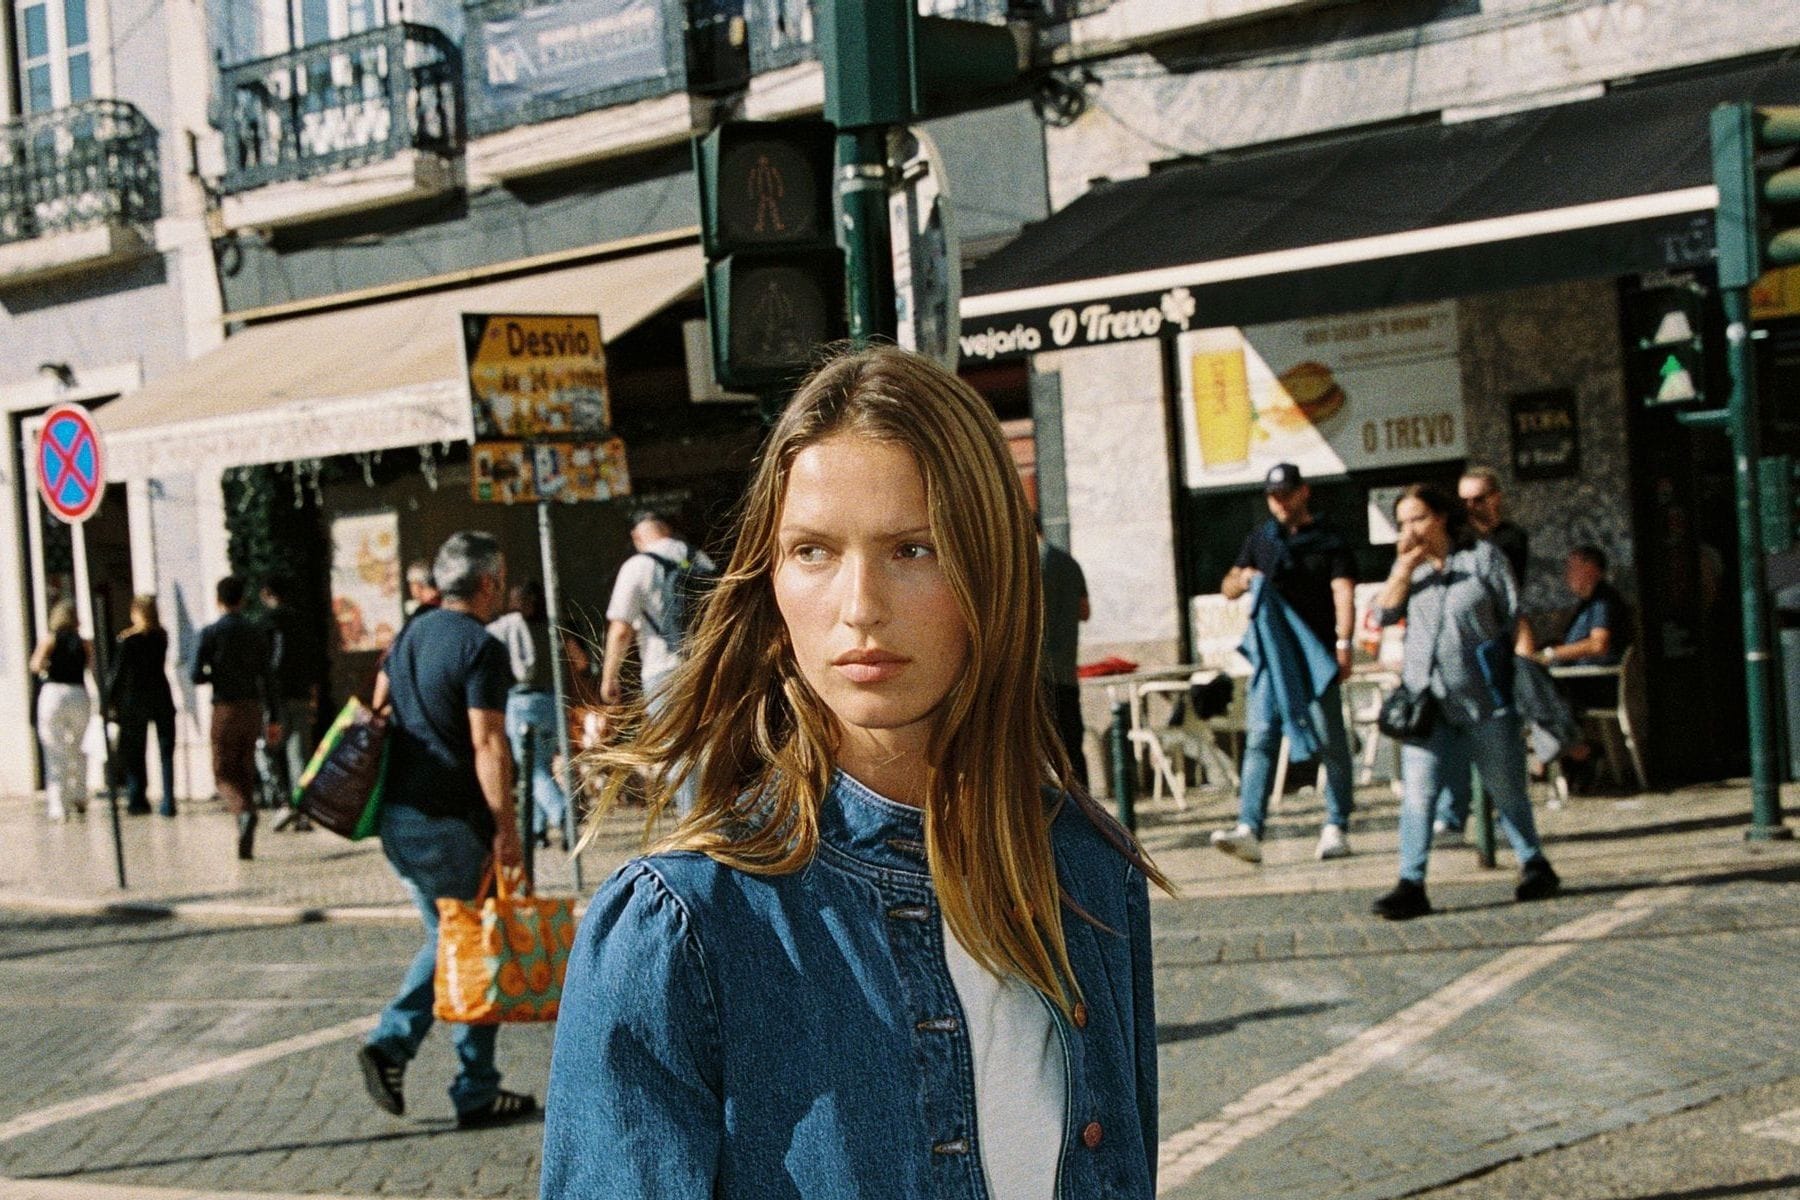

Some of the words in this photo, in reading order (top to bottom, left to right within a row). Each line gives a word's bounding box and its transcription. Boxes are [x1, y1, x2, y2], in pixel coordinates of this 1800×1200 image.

[506, 321, 590, 357] Desvio
[1049, 307, 1078, 347] O
[1080, 304, 1162, 342] Trevo
